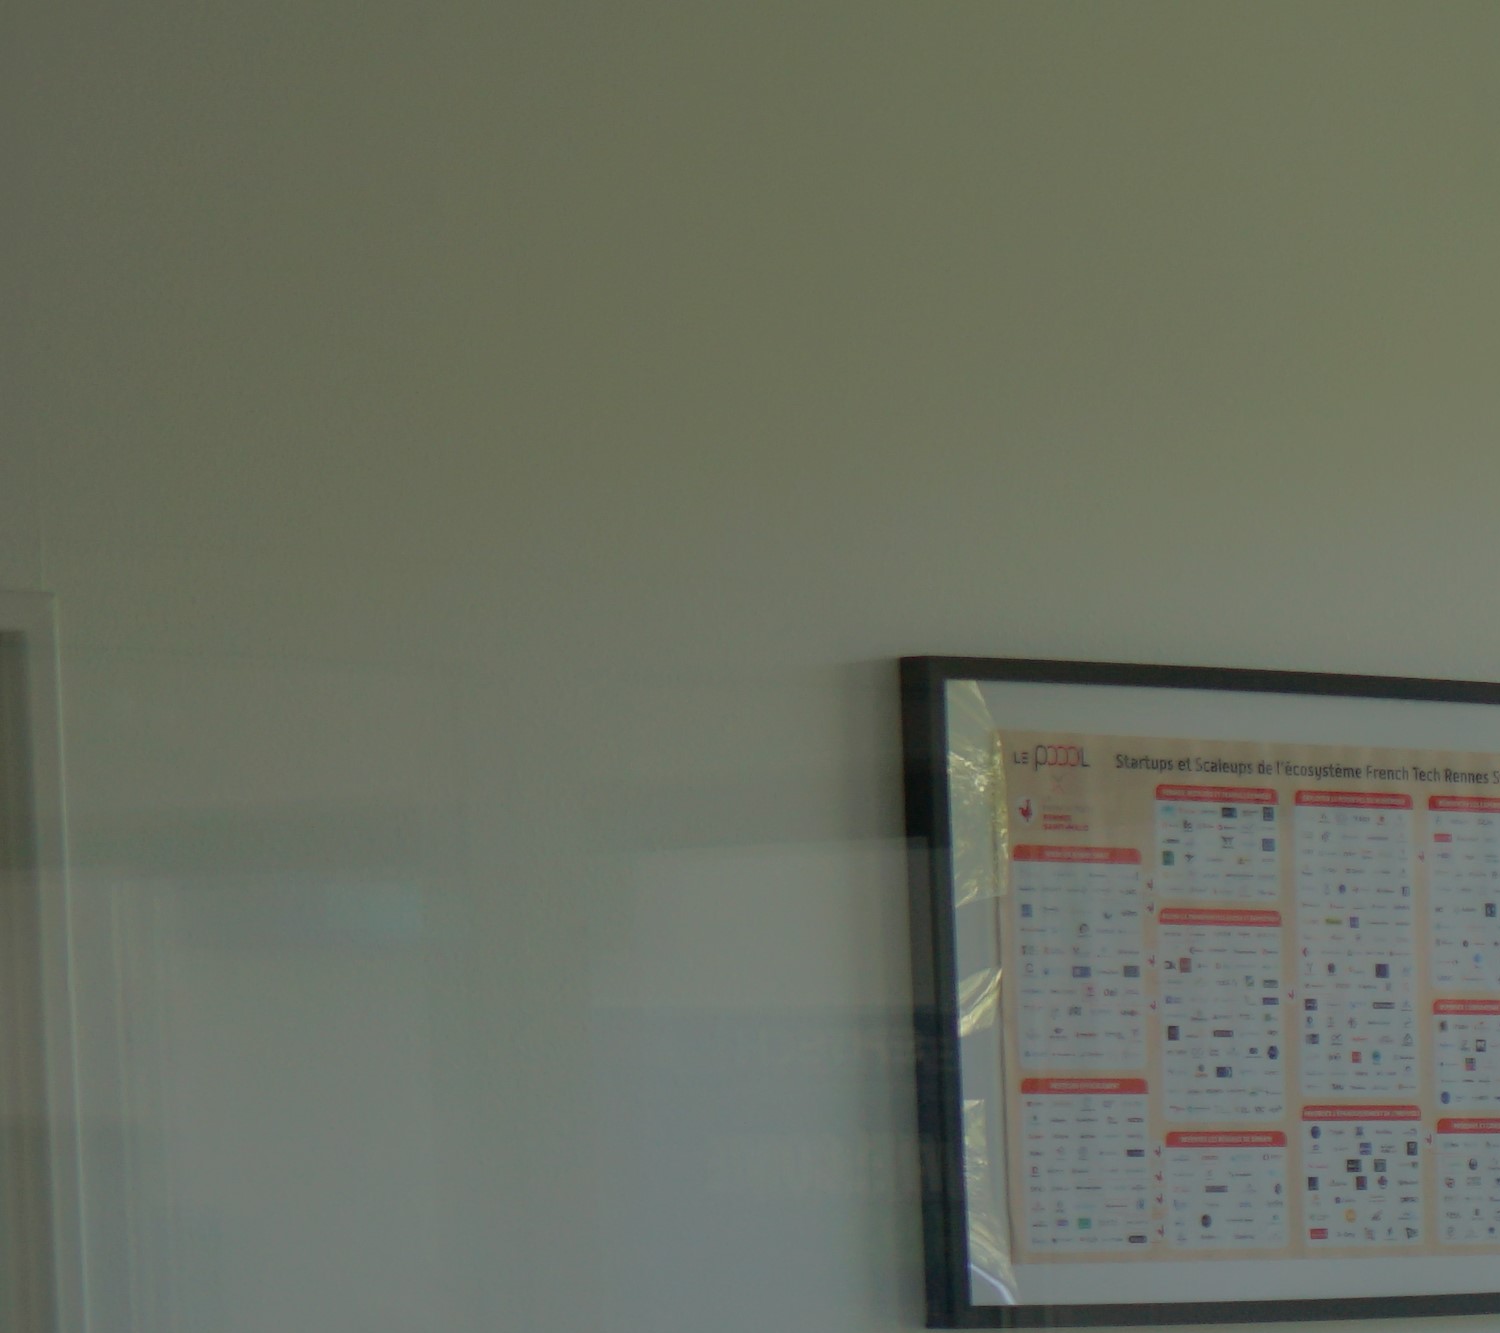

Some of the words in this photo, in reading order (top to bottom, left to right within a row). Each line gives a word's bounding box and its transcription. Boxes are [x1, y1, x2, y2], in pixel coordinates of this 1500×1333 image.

[1116, 754, 1173, 773] Startups
[1178, 757, 1192, 771] et
[1258, 759, 1272, 775] de
[1366, 765, 1409, 780] French
[1412, 767, 1440, 782] Tech
[1445, 768, 1489, 784] Rennes
